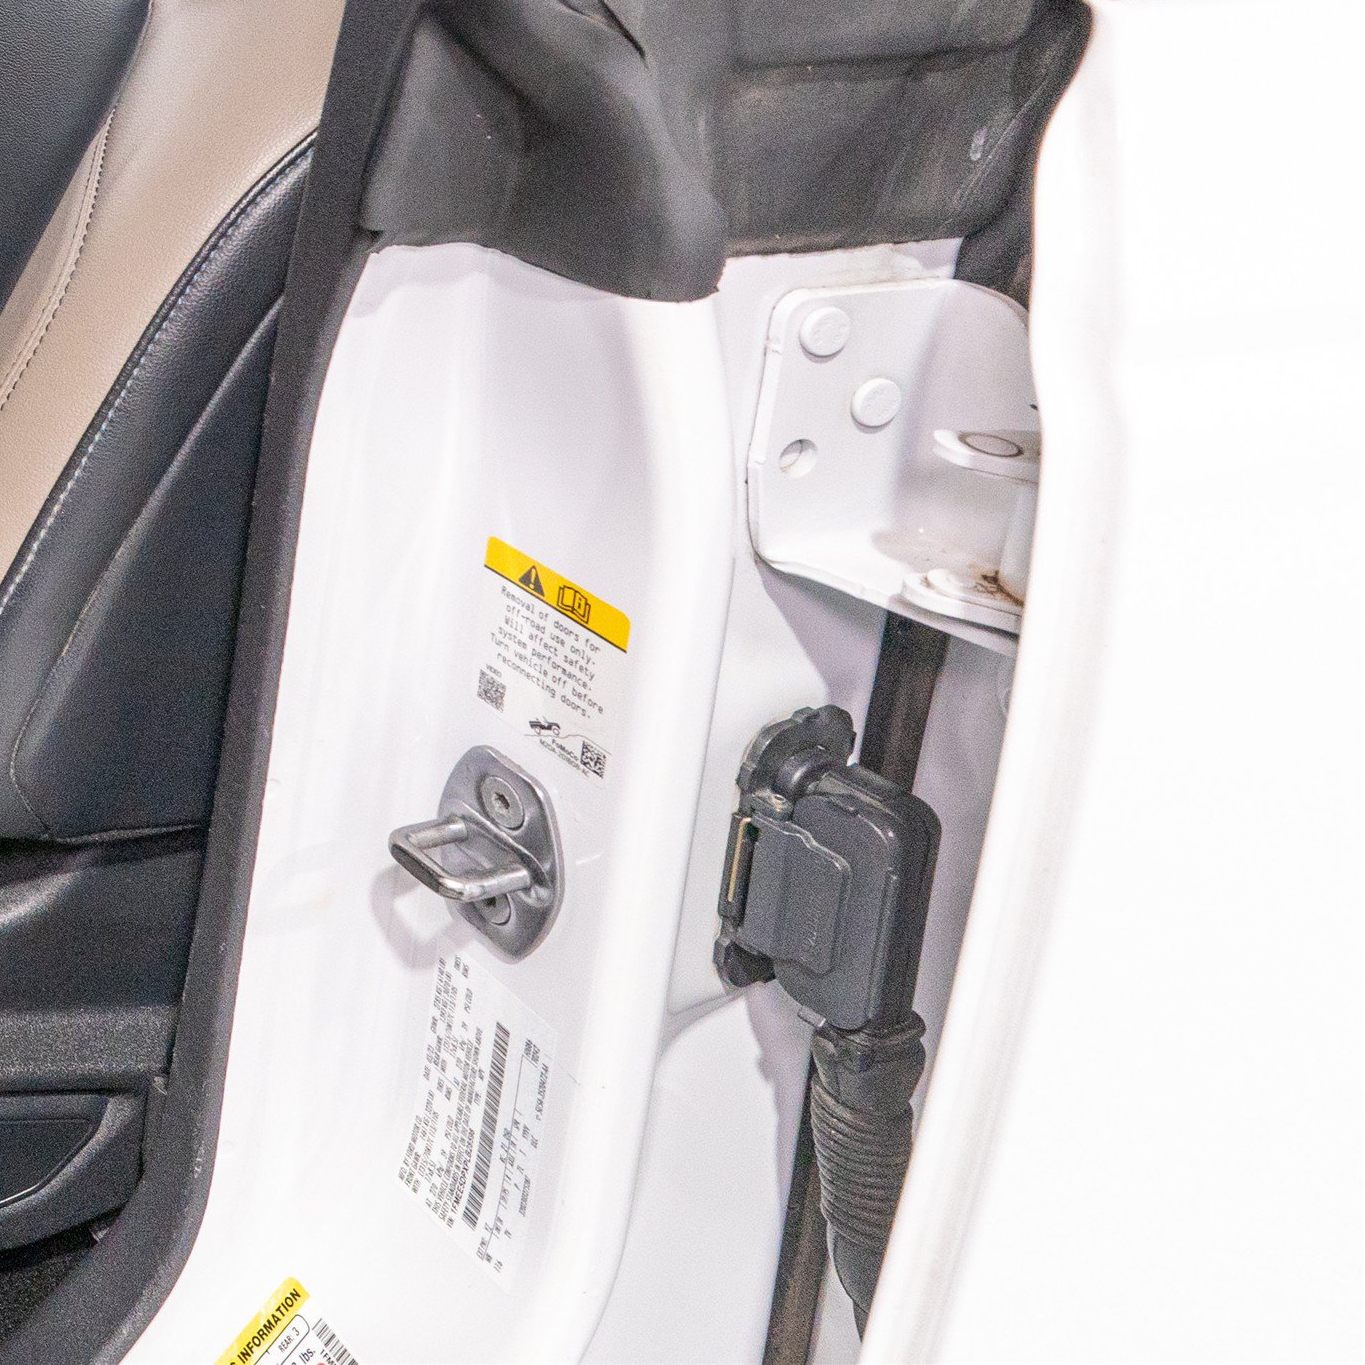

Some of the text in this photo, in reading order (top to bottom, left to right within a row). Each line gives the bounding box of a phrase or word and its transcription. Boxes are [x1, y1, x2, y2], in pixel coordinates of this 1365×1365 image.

[501, 586, 600, 653] Removal of doors for
[504, 616, 595, 681] Will affect safety
[506, 605, 596, 666] off-road use only.
[490, 633, 604, 714] Turn vehicle off before
[497, 653, 590, 719] reconnecting doors.
[498, 627, 592, 691] system performance.
[552, 739, 579, 761] FoMoCo
[406, 1141, 414, 1159] FORD
[410, 1122, 419, 1144] MOTOR
[432, 1198, 440, 1215] THIS
[437, 1178, 447, 1203] VEHICLE
[443, 1149, 454, 1181] CONFORMS
[464, 1039, 473, 1061] VEHICLE
[438, 1198, 448, 1222] SAFETY
[446, 1168, 458, 1203] STANDARDS
[464, 1066, 477, 1104] MANUFACTURE
[471, 1045, 479, 1066] SHOWN
[405, 1165, 414, 1188] FRONT
[237, 1288, 302, 1364] INFORMATION
[292, 1327, 300, 1336] 3
[299, 1348, 316, 1365] lbs.
